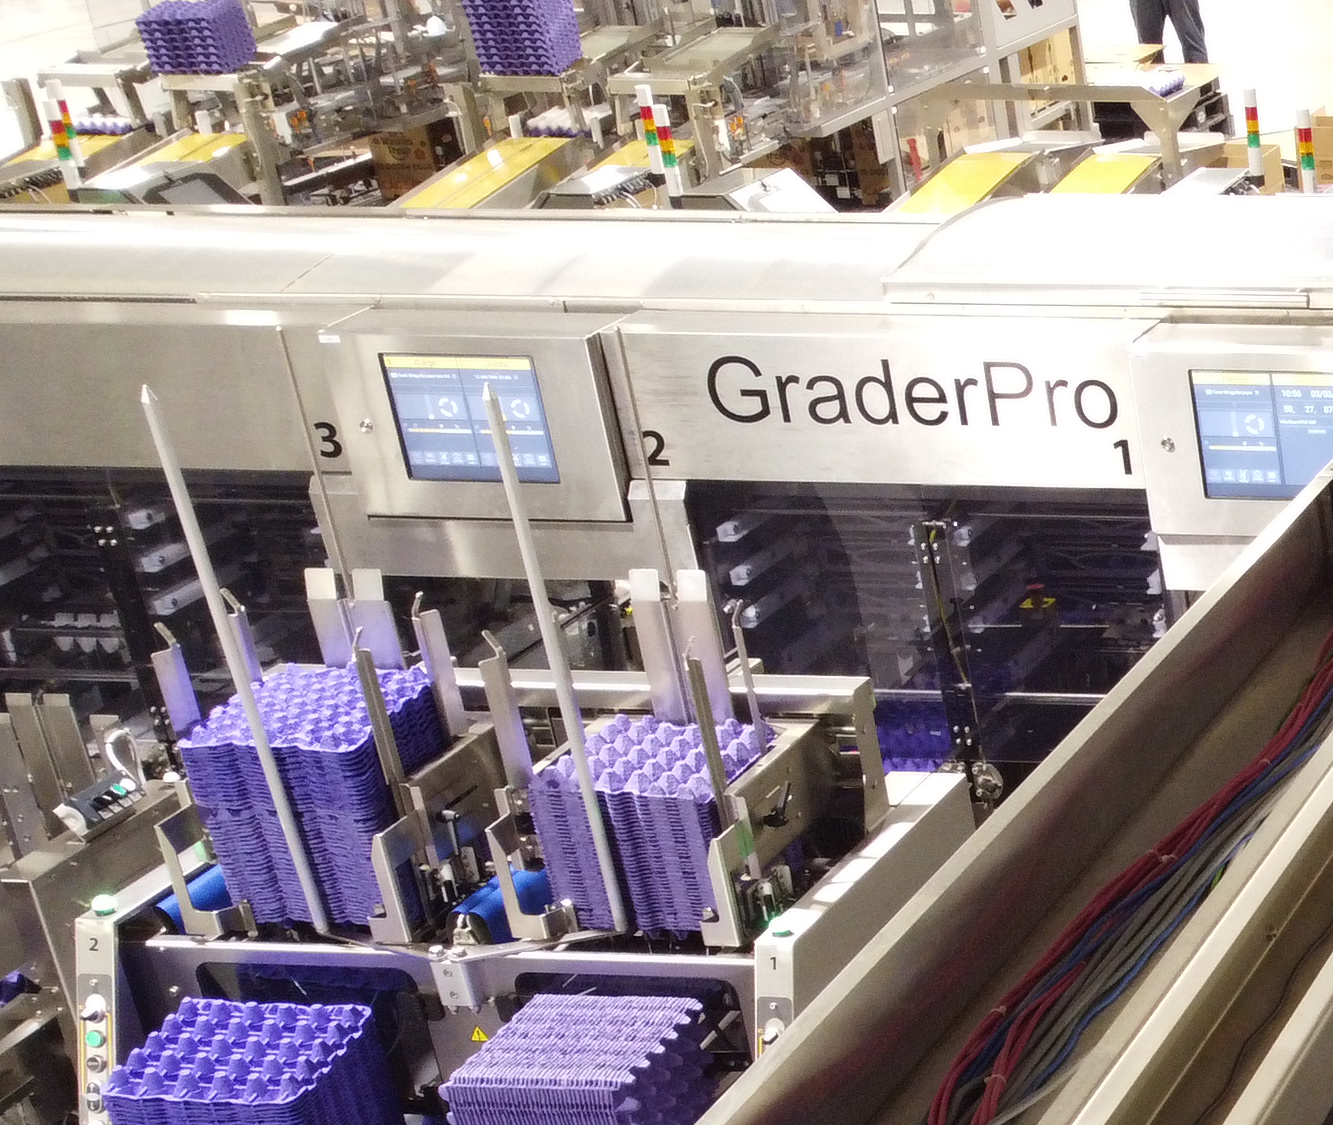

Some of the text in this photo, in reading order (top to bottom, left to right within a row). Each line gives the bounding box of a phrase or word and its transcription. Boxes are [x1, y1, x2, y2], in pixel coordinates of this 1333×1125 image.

[707, 355, 1118, 429] GraderPro
[313, 421, 342, 458] 3
[642, 430, 670, 466] 2
[1113, 439, 1132, 475] 1
[89, 937, 99, 951] 2
[770, 956, 777, 970] 1
